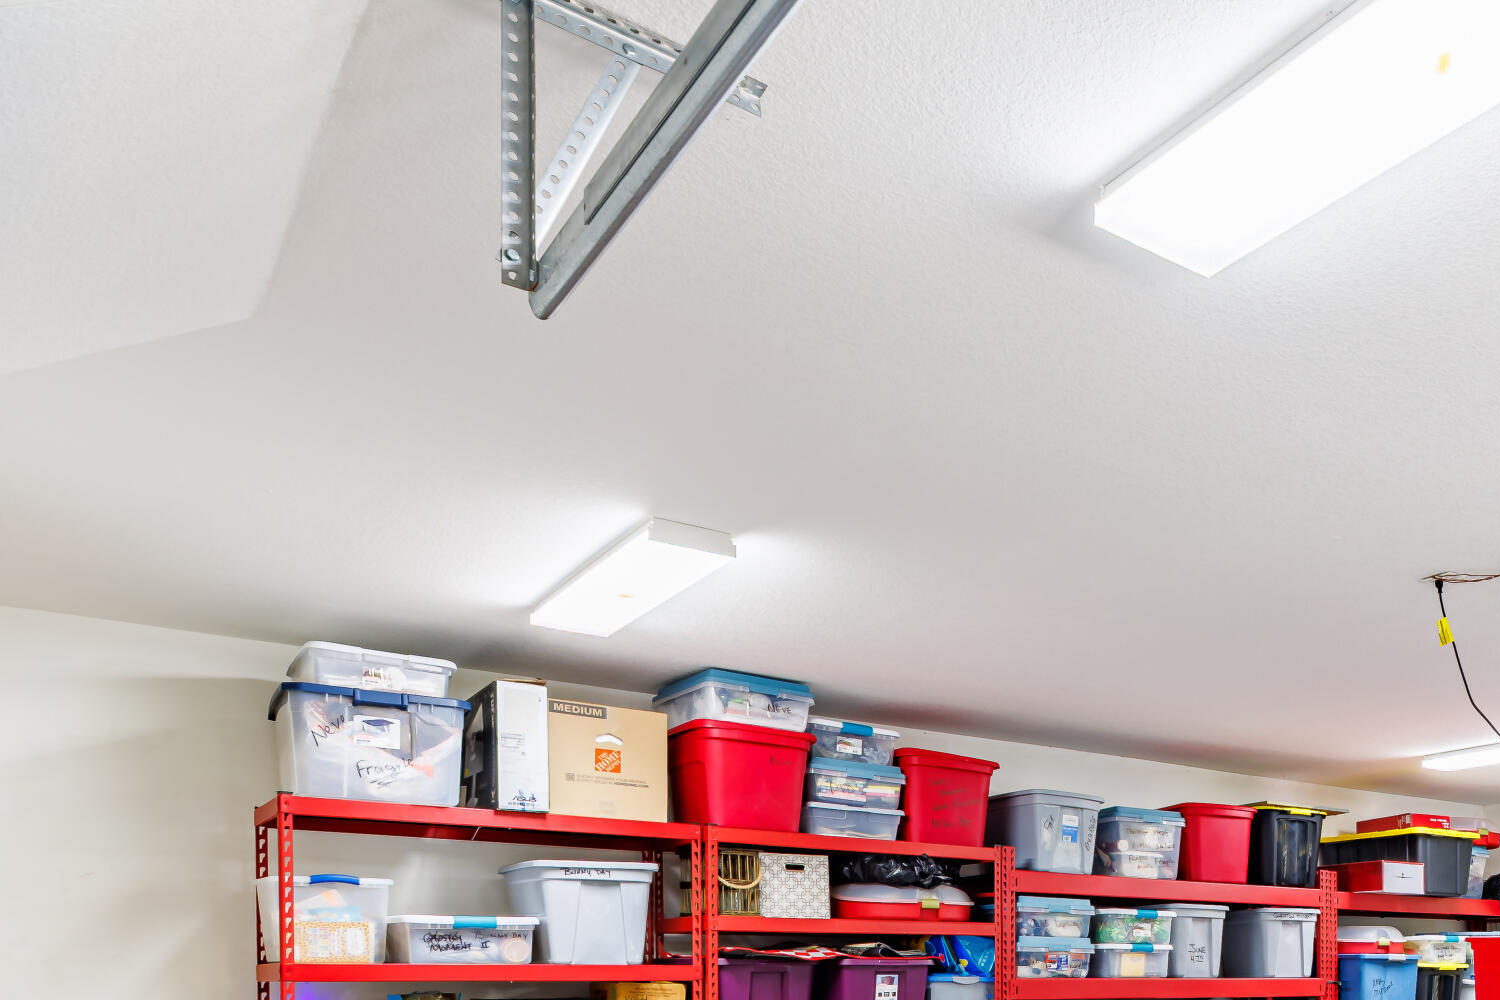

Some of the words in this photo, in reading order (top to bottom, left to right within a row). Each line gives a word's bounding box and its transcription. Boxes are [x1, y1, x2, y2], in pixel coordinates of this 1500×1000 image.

[553, 702, 603, 717] MEDIUM
[767, 704, 792, 714] NEVE
[595, 750, 621, 773] HOME
